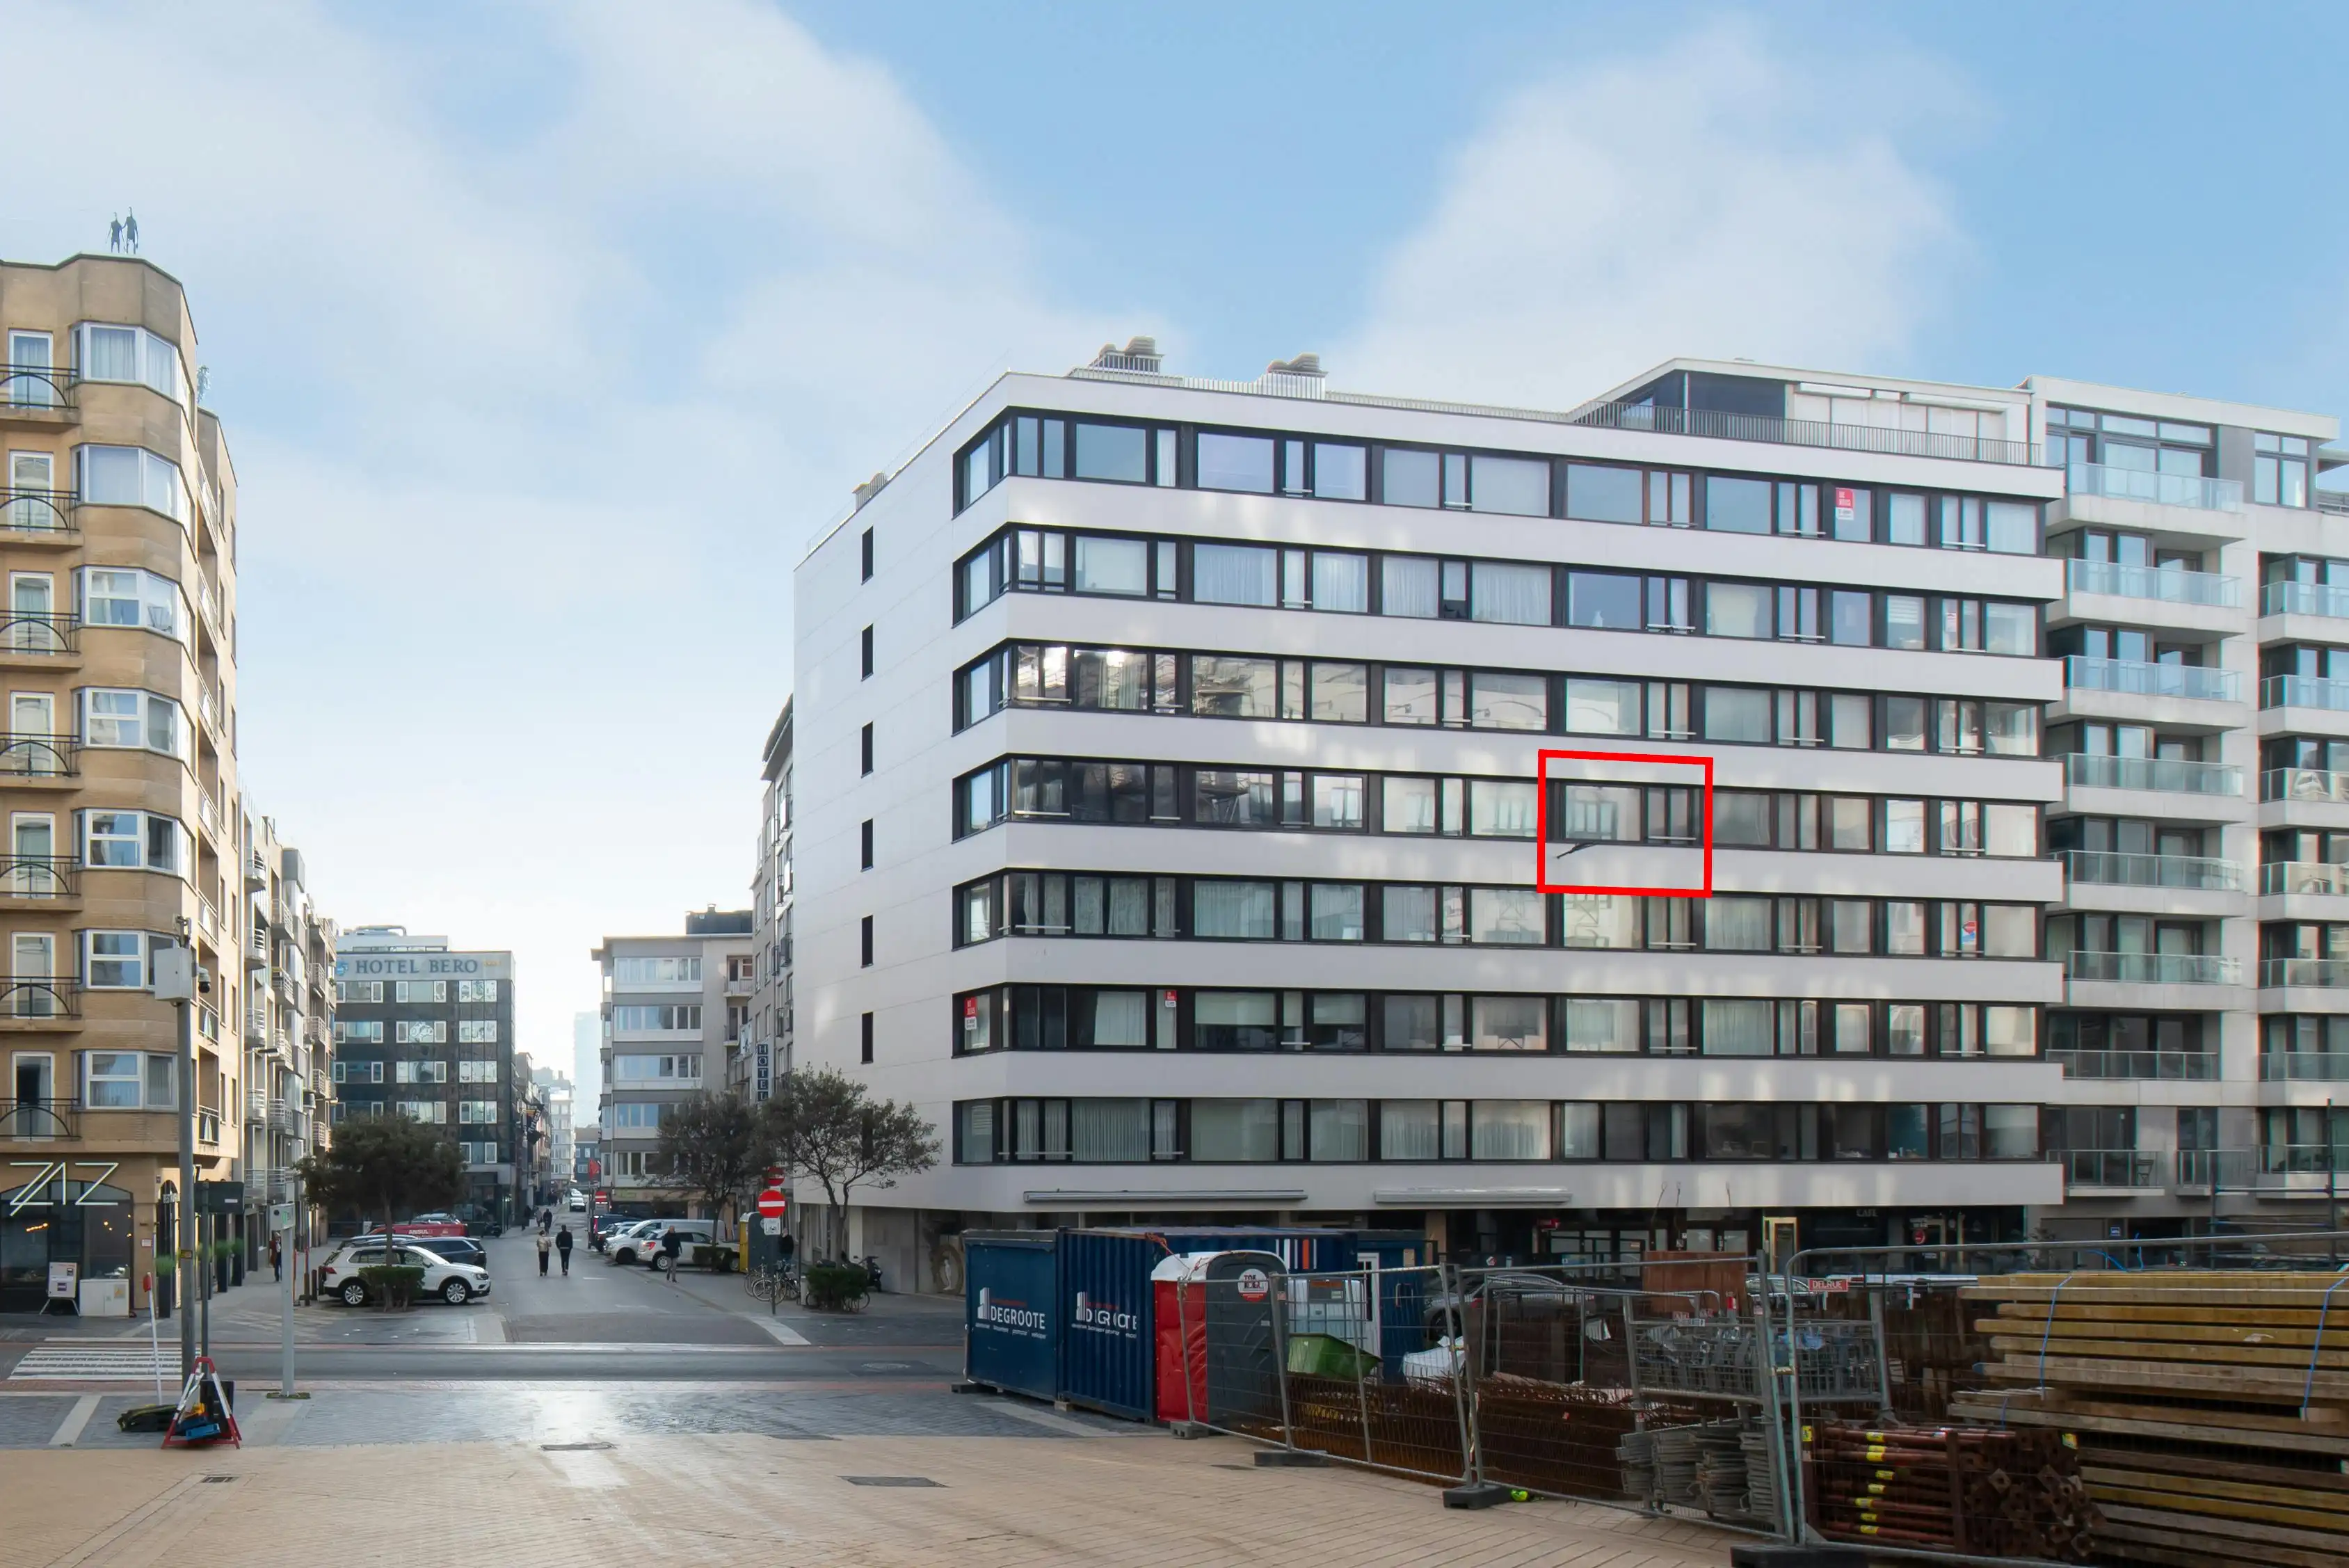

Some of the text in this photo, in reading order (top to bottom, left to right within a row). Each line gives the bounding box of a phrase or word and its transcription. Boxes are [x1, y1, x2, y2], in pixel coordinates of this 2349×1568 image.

[355, 959, 479, 974] HOTEL BERO
[991, 1305, 1045, 1329] DEGROOTE
